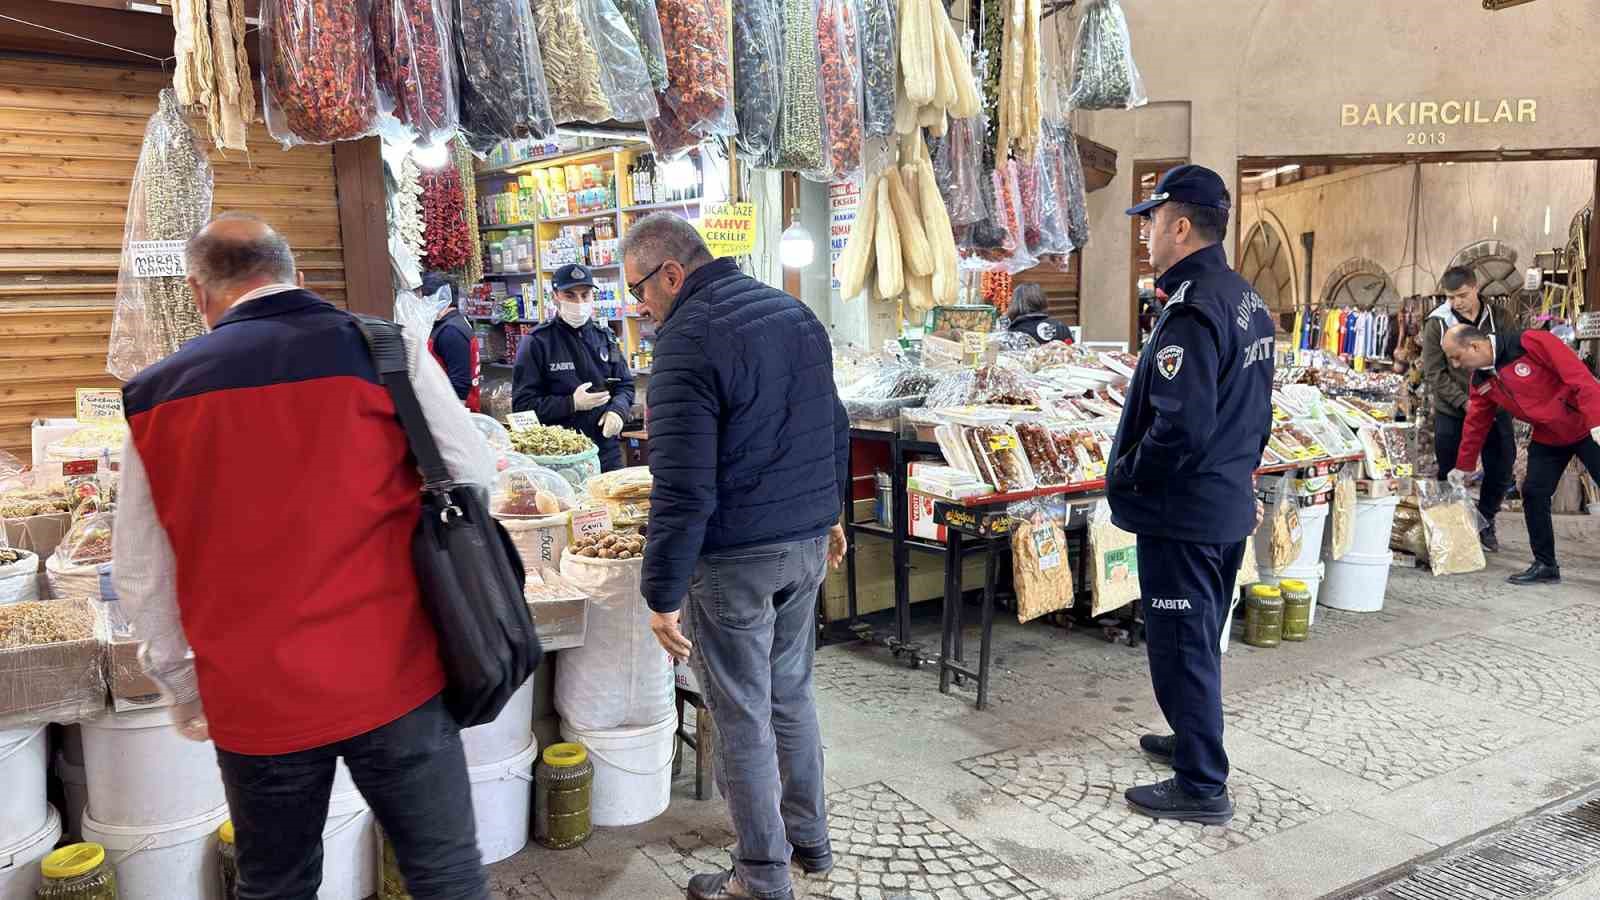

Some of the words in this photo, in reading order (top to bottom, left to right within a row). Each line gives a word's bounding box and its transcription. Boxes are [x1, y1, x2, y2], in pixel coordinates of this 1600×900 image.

[1341, 99, 1536, 126] BAKIRCILAR
[1407, 132, 1446, 145] 2013
[705, 218, 752, 230] KAHVE
[549, 362, 575, 371] ZABITA
[1151, 598, 1191, 609] ZABITA
